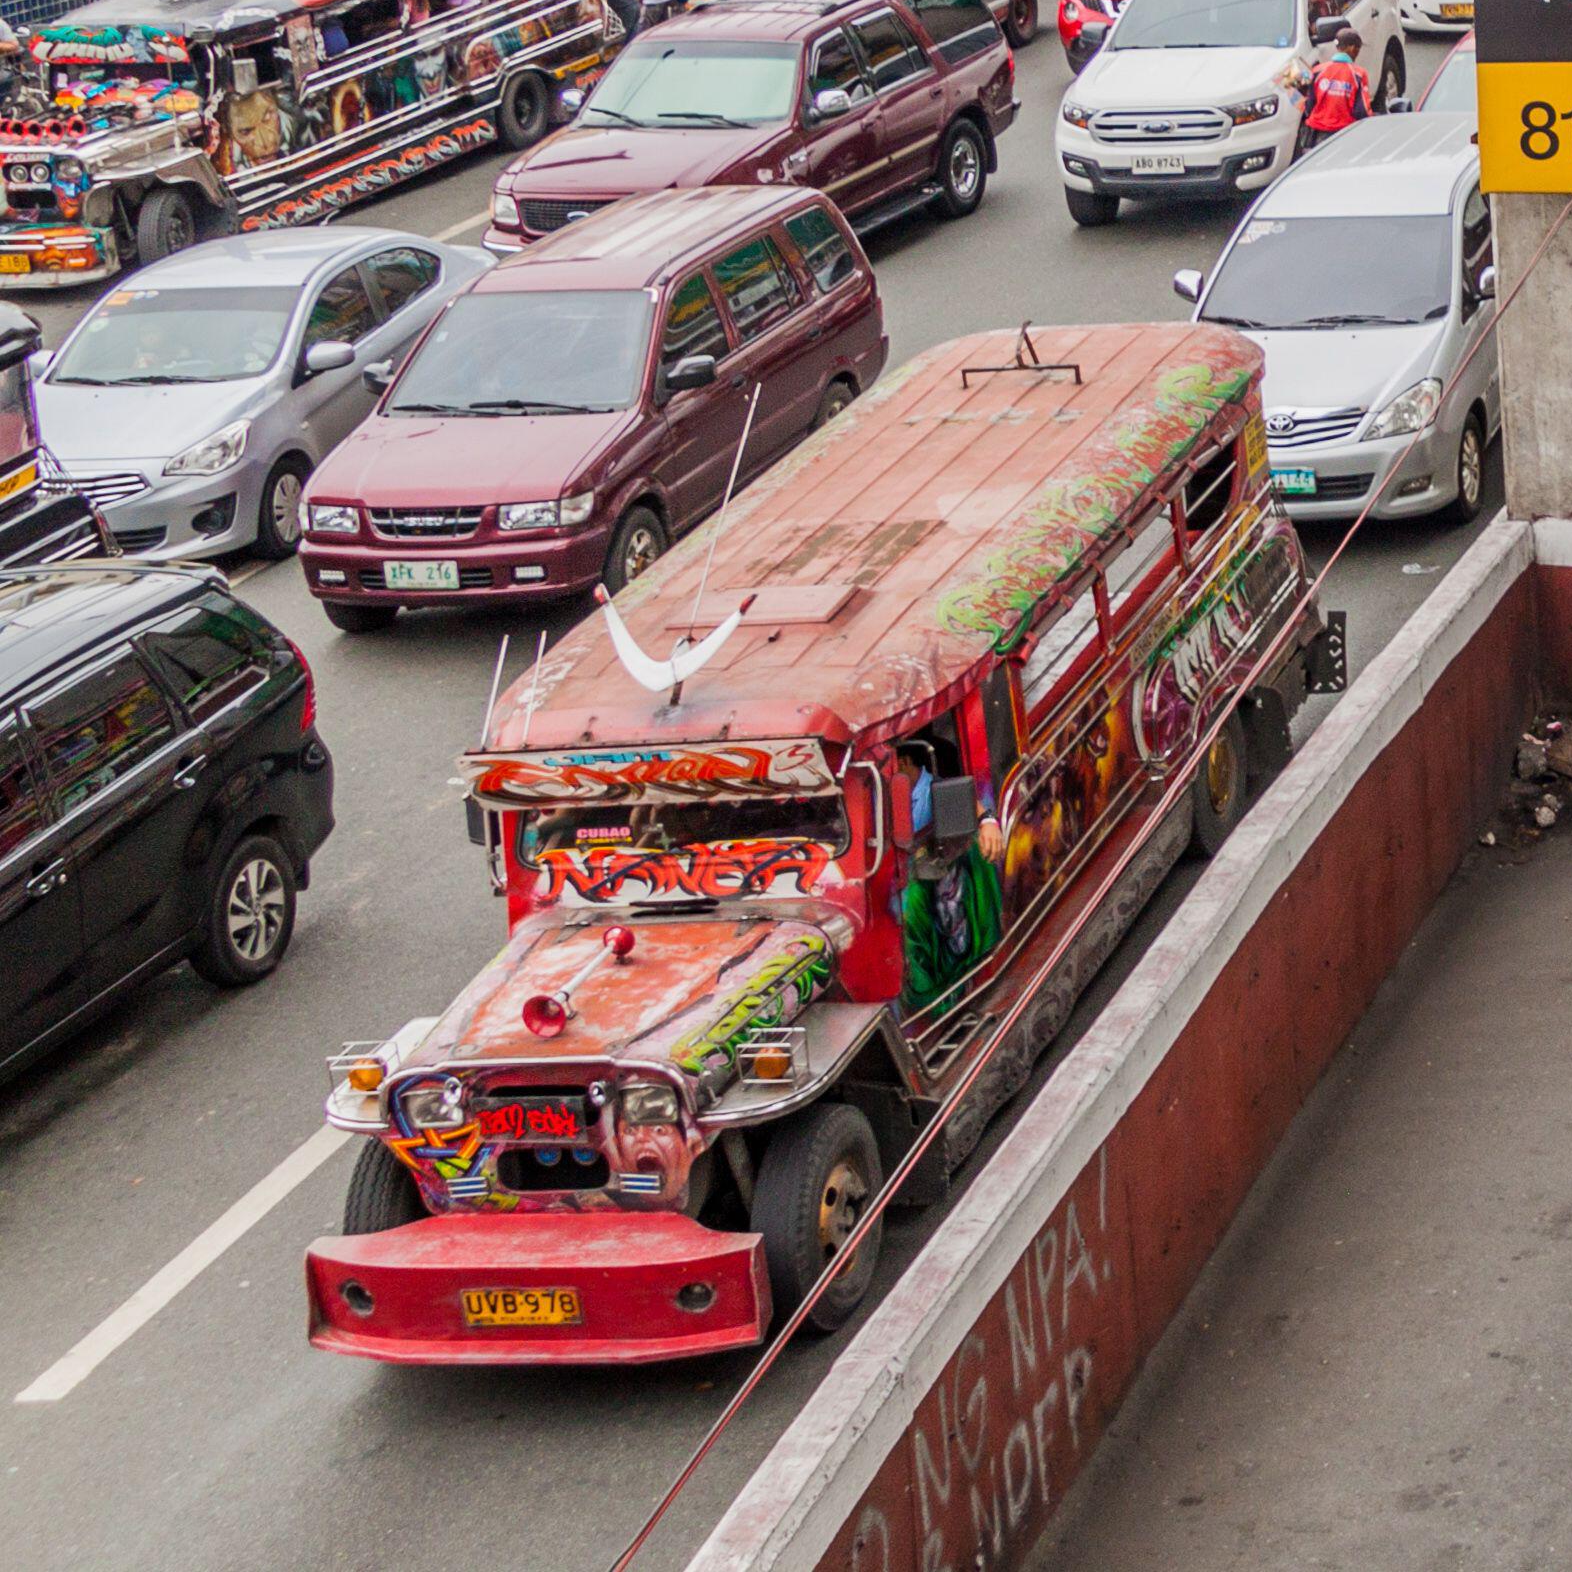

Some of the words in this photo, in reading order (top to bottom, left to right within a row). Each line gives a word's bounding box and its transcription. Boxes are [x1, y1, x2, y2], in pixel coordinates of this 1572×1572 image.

[576, 827, 632, 841] CUBAO
[464, 1291, 521, 1318] UVB
[527, 1290, 578, 1316] 978
